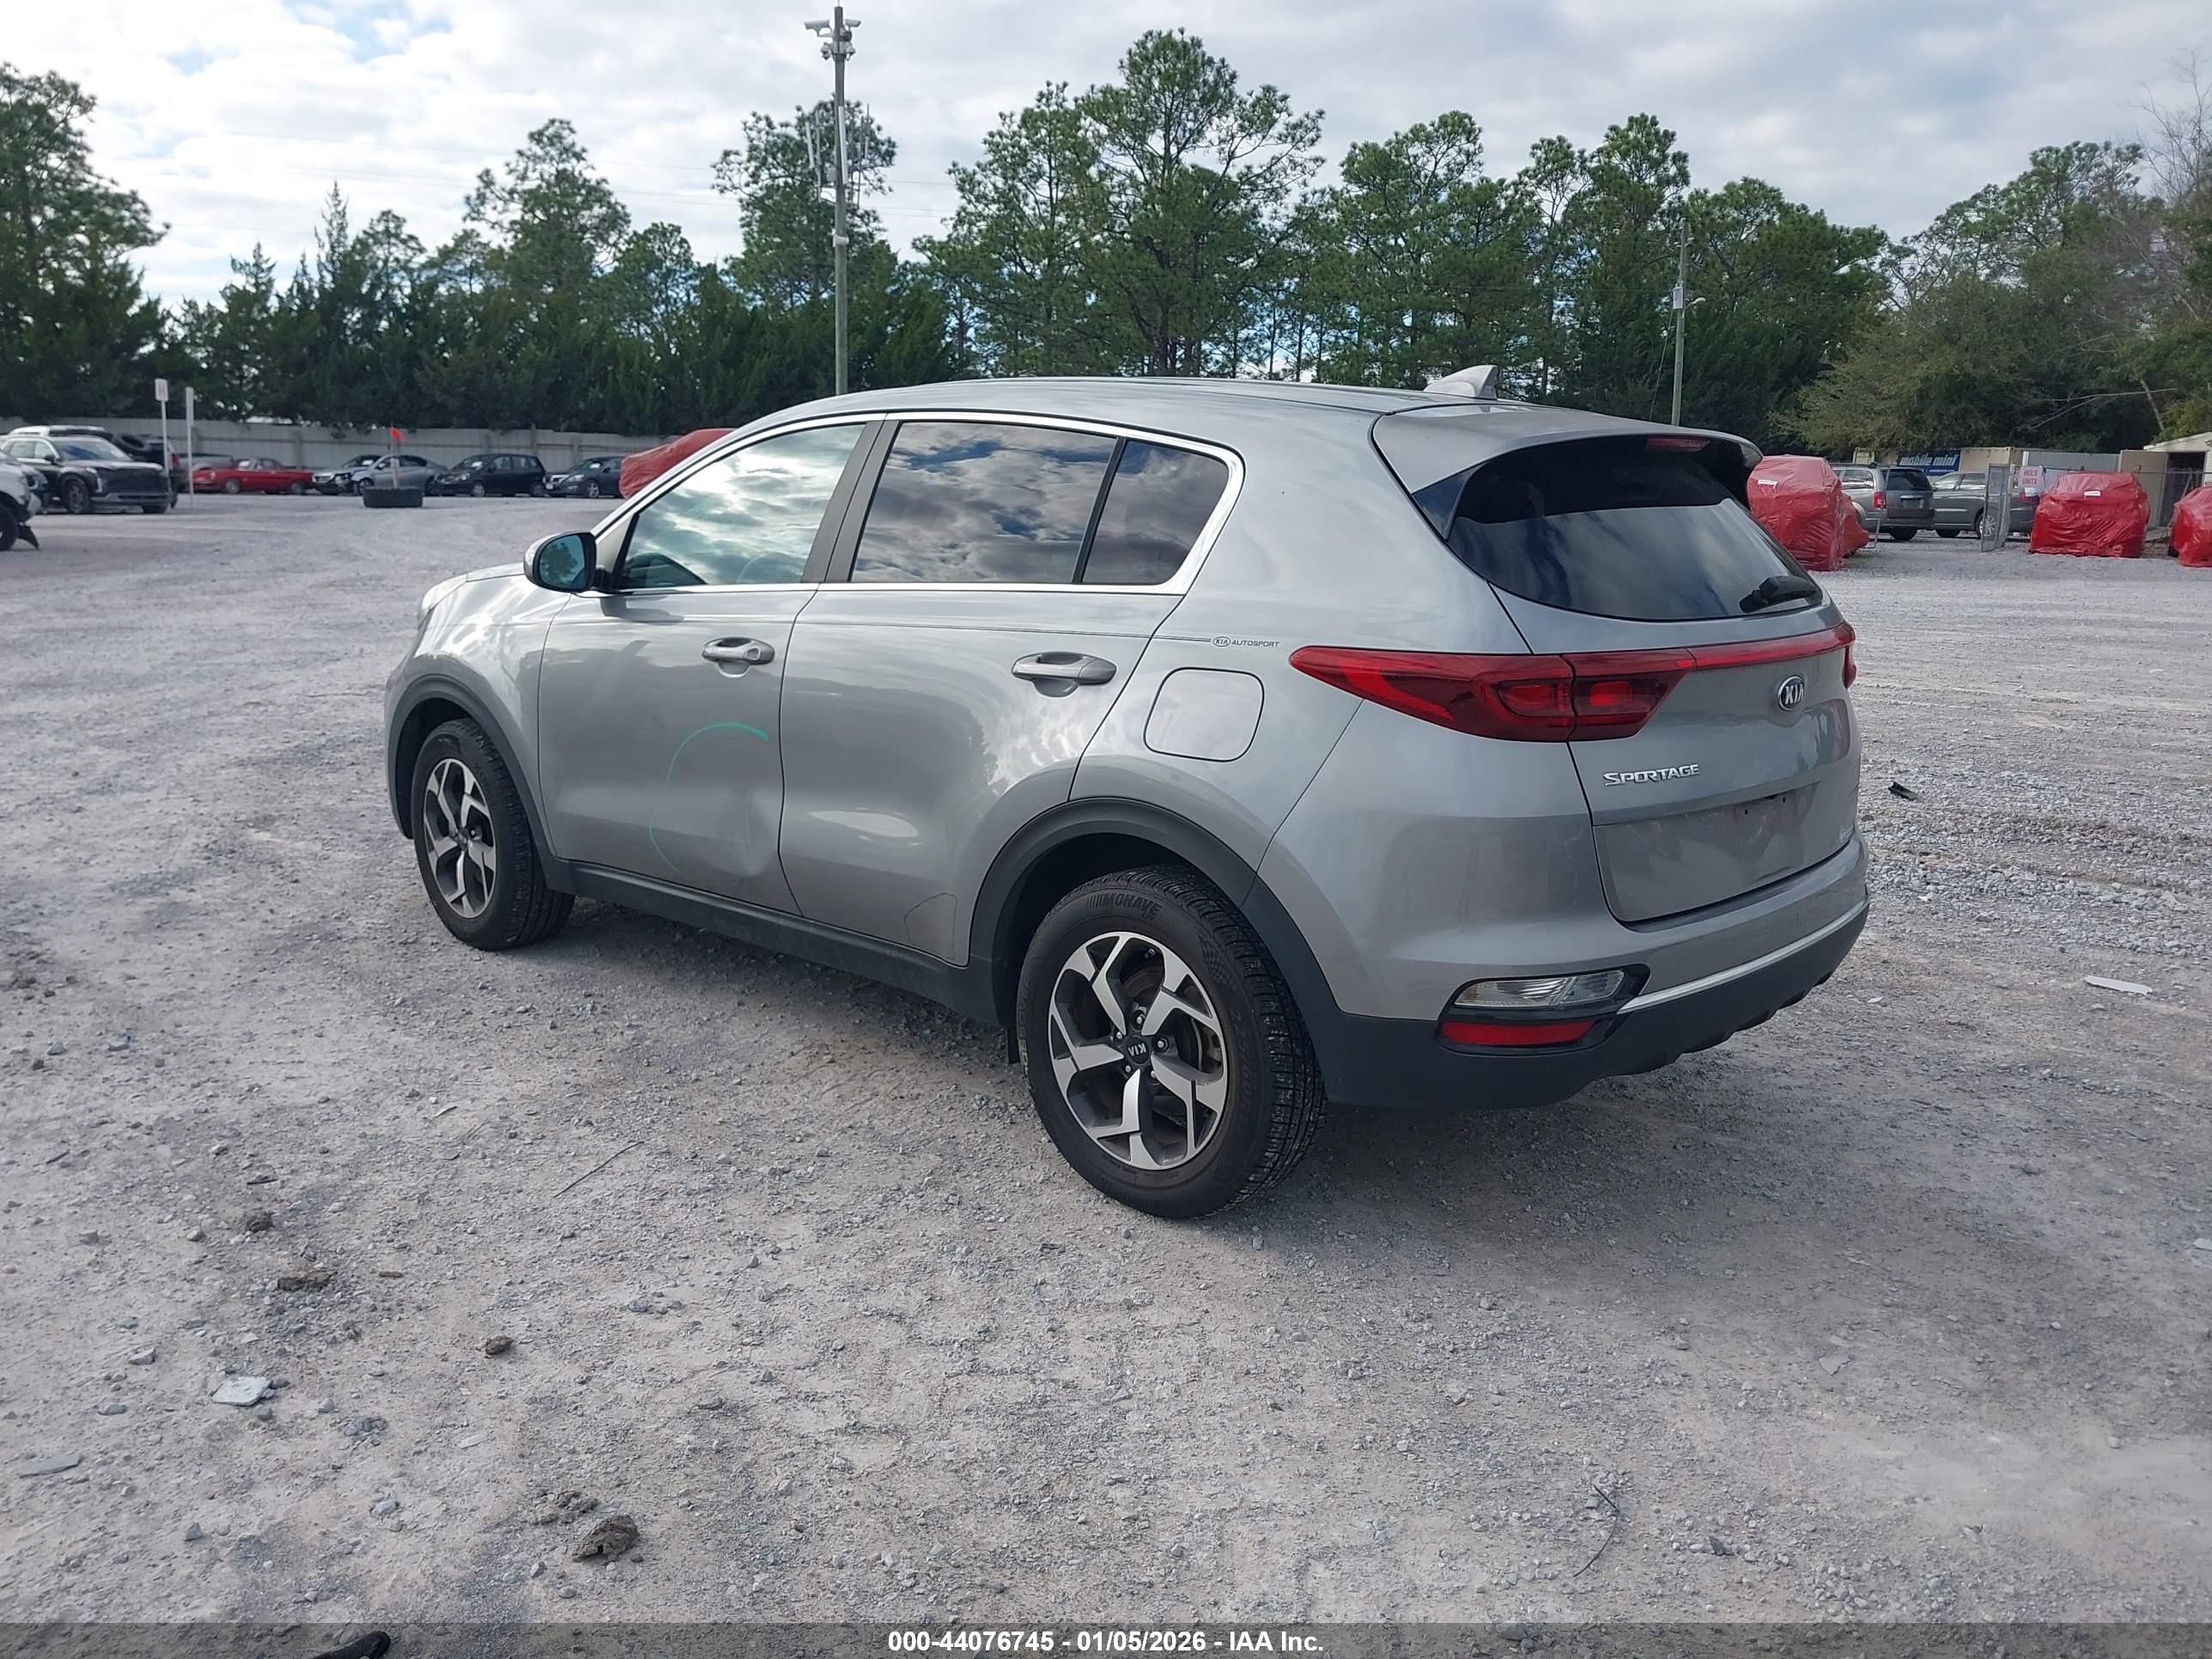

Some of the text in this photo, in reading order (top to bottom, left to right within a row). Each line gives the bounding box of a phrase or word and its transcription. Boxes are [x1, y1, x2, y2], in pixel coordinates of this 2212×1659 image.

[1899, 453, 1960, 466] mobile mini
[1231, 639, 1279, 647] AUTOSPORT
[1784, 683, 1804, 705] KIA
[1602, 763, 1700, 787] SPORTAGE
[1127, 1042, 1147, 1056] KIA
